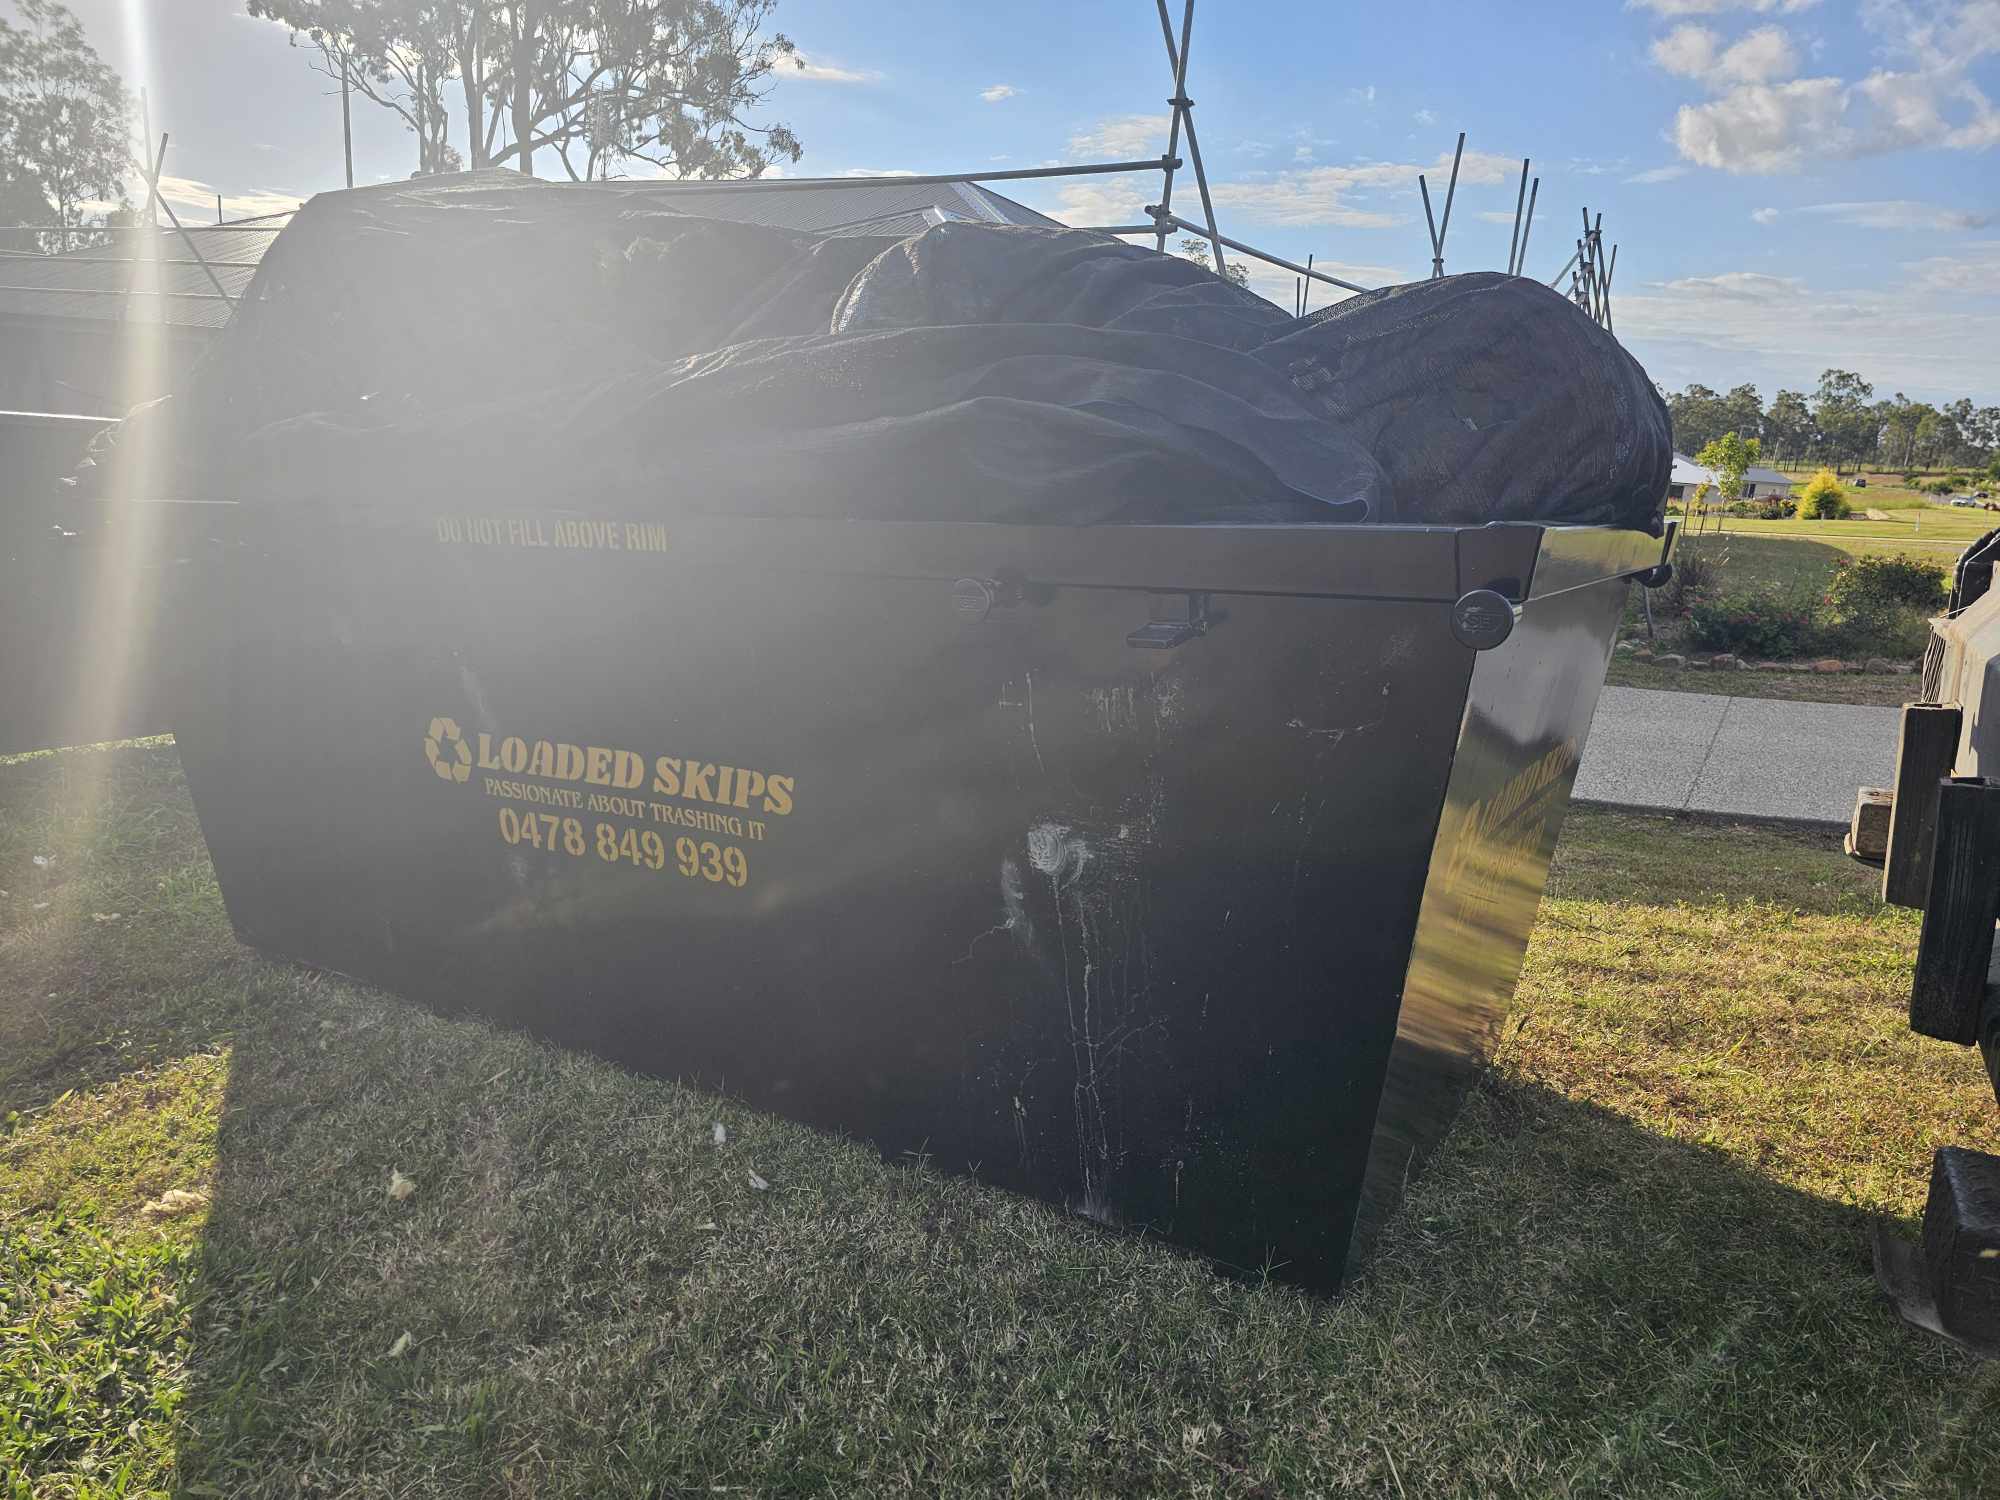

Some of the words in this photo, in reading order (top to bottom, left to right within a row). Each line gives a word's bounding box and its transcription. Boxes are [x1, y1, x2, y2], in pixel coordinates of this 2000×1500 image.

[437, 516, 460, 543] DO
[466, 516, 503, 545] NOT
[508, 519, 548, 547] FILL
[554, 519, 620, 550] ABOVE
[625, 523, 668, 552] RIM
[478, 733, 645, 789] LOADED
[653, 756, 795, 815] SKIPS
[485, 777, 584, 810] PASSIONATE
[587, 793, 646, 819] ABOUT
[650, 802, 742, 838] TRASHING
[748, 820, 766, 841] IT
[500, 807, 586, 856] 0478
[596, 823, 665, 870] 849
[675, 836, 748, 887] 939
